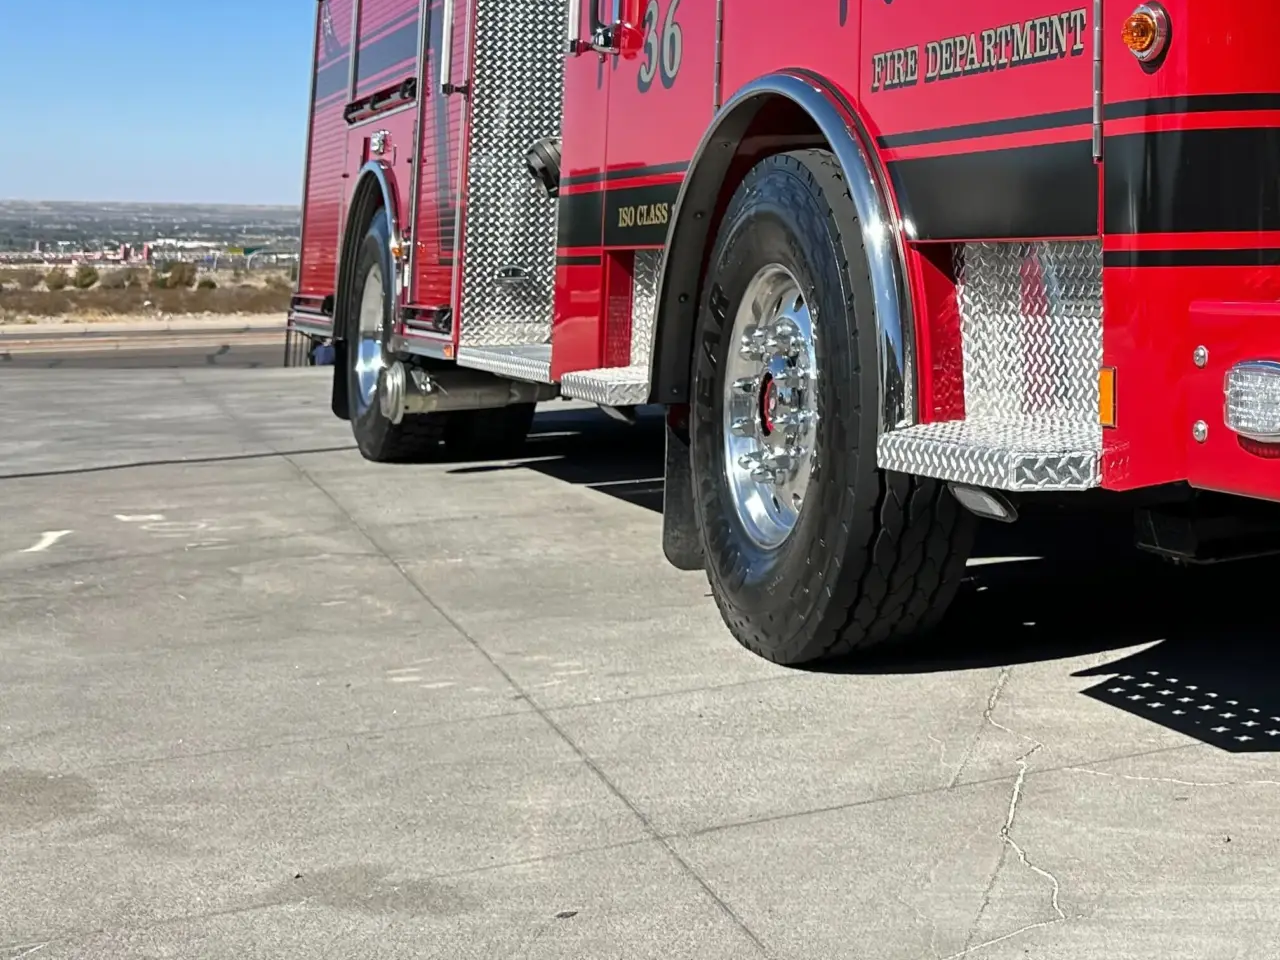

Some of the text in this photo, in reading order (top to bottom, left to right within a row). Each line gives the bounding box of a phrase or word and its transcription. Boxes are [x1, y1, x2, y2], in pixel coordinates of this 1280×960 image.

[872, 7, 1087, 91] FIRE DEPARTMENT
[618, 206, 635, 227] ISO
[637, 203, 668, 226] CLASS
